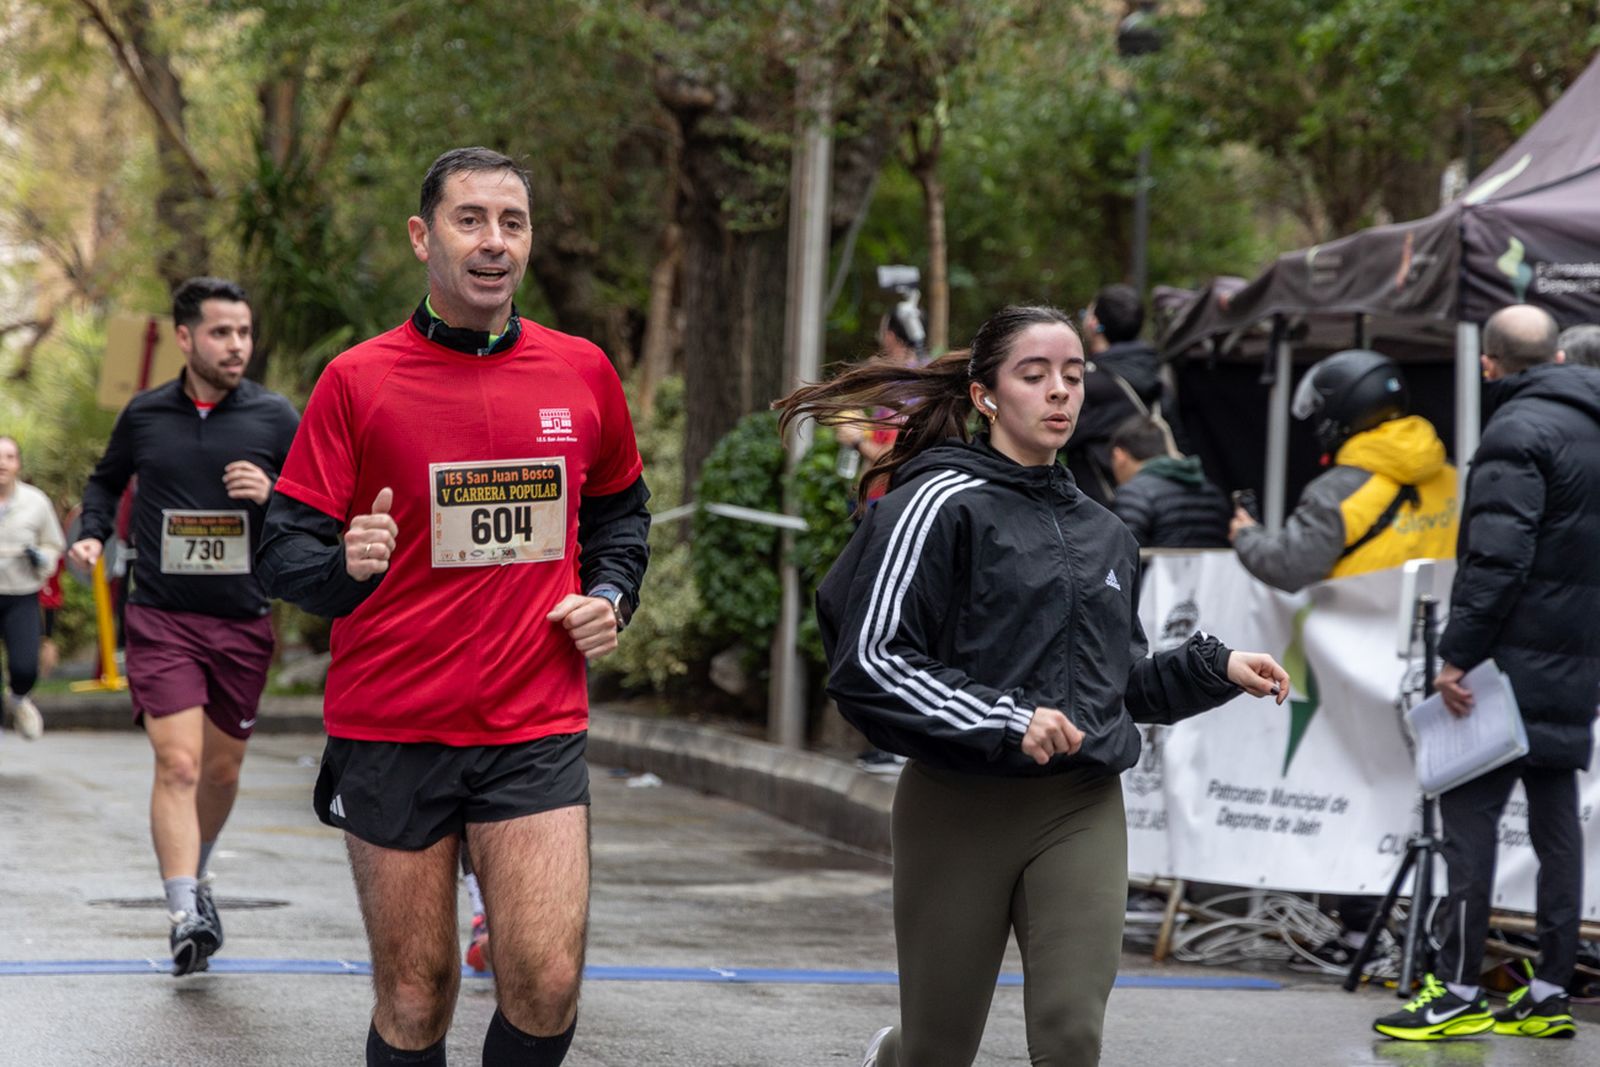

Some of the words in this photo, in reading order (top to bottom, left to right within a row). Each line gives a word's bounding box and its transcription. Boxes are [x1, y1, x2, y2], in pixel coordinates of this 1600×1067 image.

[444, 472, 463, 486] IES
[466, 471, 488, 484] San
[492, 469, 518, 483] Juan
[522, 467, 555, 481] Bosco
[442, 488, 451, 503] V
[454, 485, 506, 502] CARRERA
[509, 482, 557, 499] POPULAR
[471, 506, 532, 545] 604
[185, 539, 224, 561] 730
[1206, 779, 1268, 805] Patronato
[1269, 787, 1332, 812] Municipal
[1330, 796, 1349, 814] de
[1215, 806, 1272, 831] Deportes
[1273, 815, 1290, 833] de
